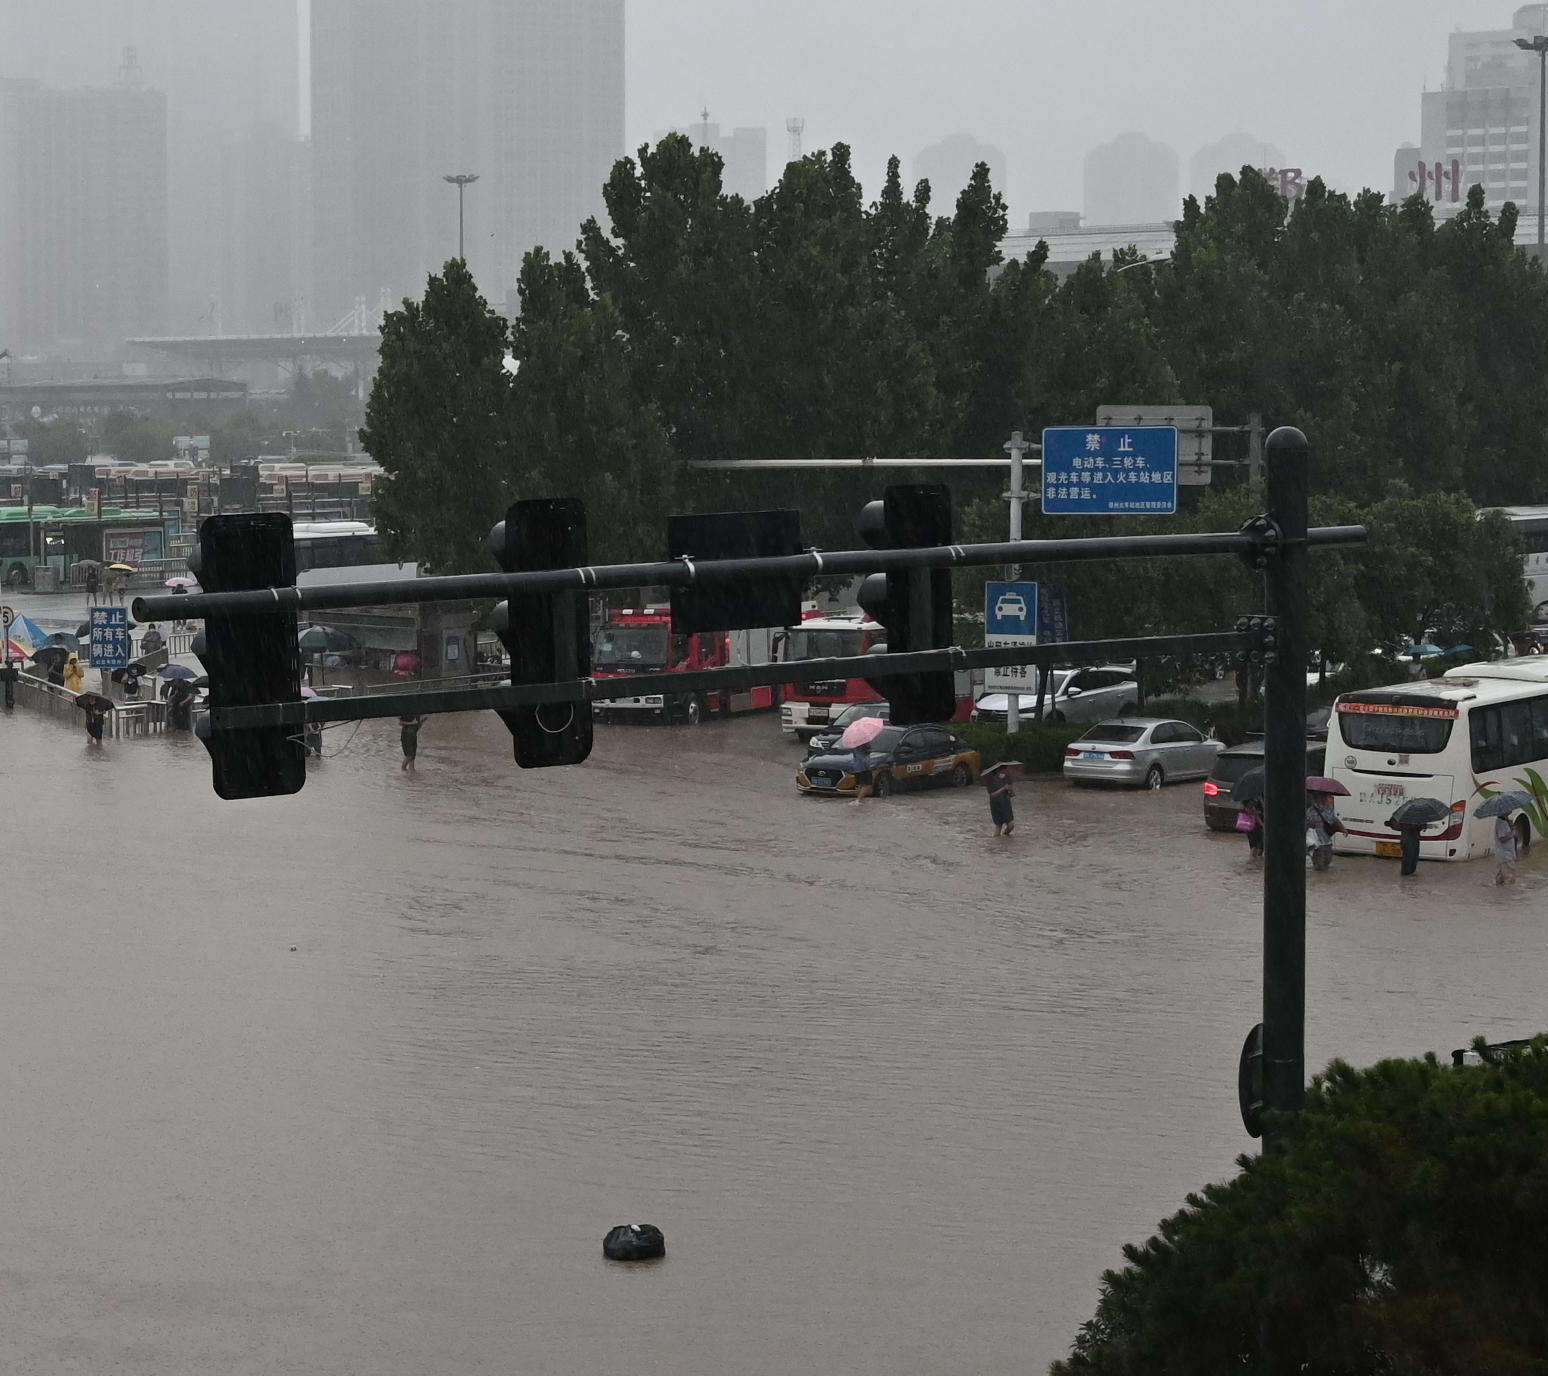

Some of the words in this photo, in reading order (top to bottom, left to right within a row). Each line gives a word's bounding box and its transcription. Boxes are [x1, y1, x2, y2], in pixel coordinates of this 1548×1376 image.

[1085, 433, 1134, 451] 禁止
[1046, 471, 1174, 484] 观光车等进入火车站地区
[2, 611, 9, 623] 5
[92, 611, 125, 625] 禁止
[92, 628, 125, 641] 所有车
[92, 644, 125, 657] 辆进入
